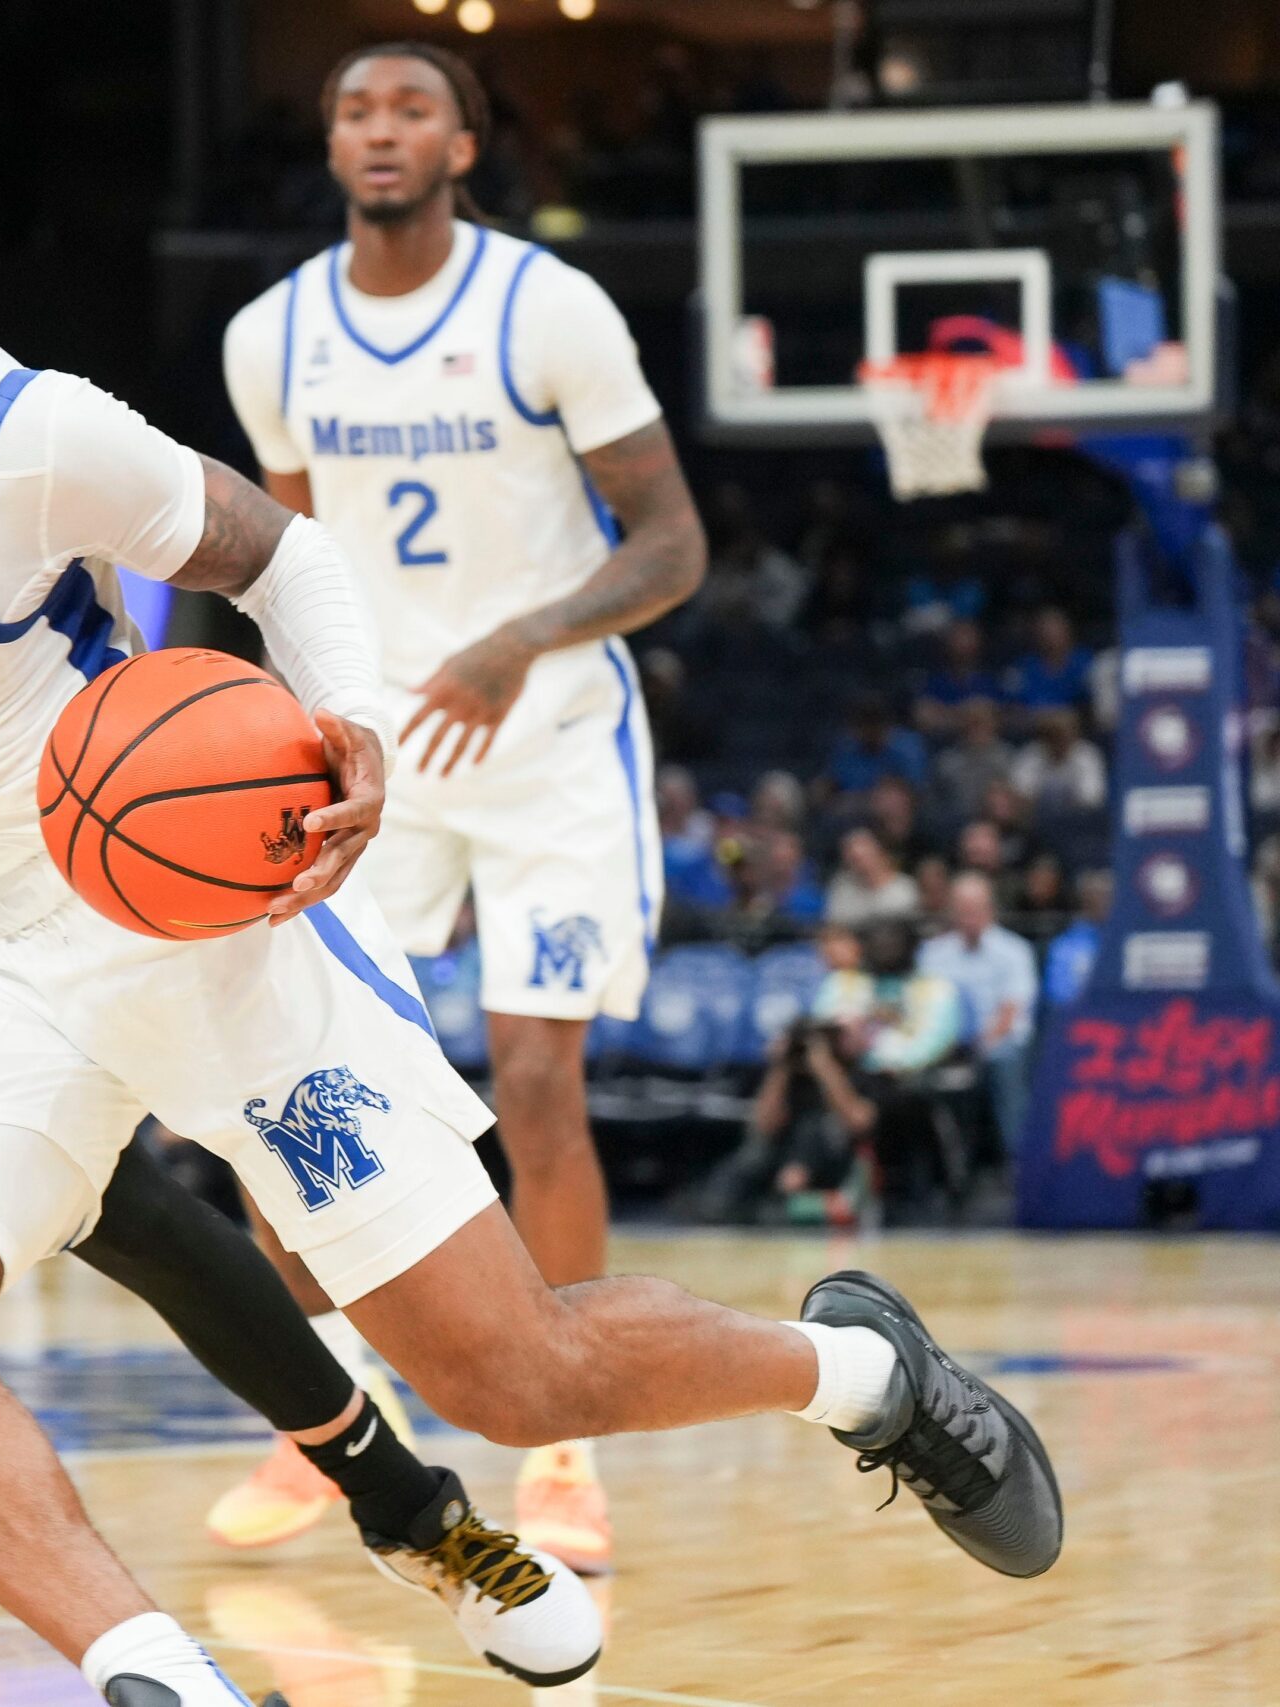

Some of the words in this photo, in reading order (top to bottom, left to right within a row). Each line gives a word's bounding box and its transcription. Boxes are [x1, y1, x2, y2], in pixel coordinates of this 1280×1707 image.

[312, 413, 498, 463] Memphis
[388, 479, 450, 567] 2
[258, 1121, 385, 1213] M
